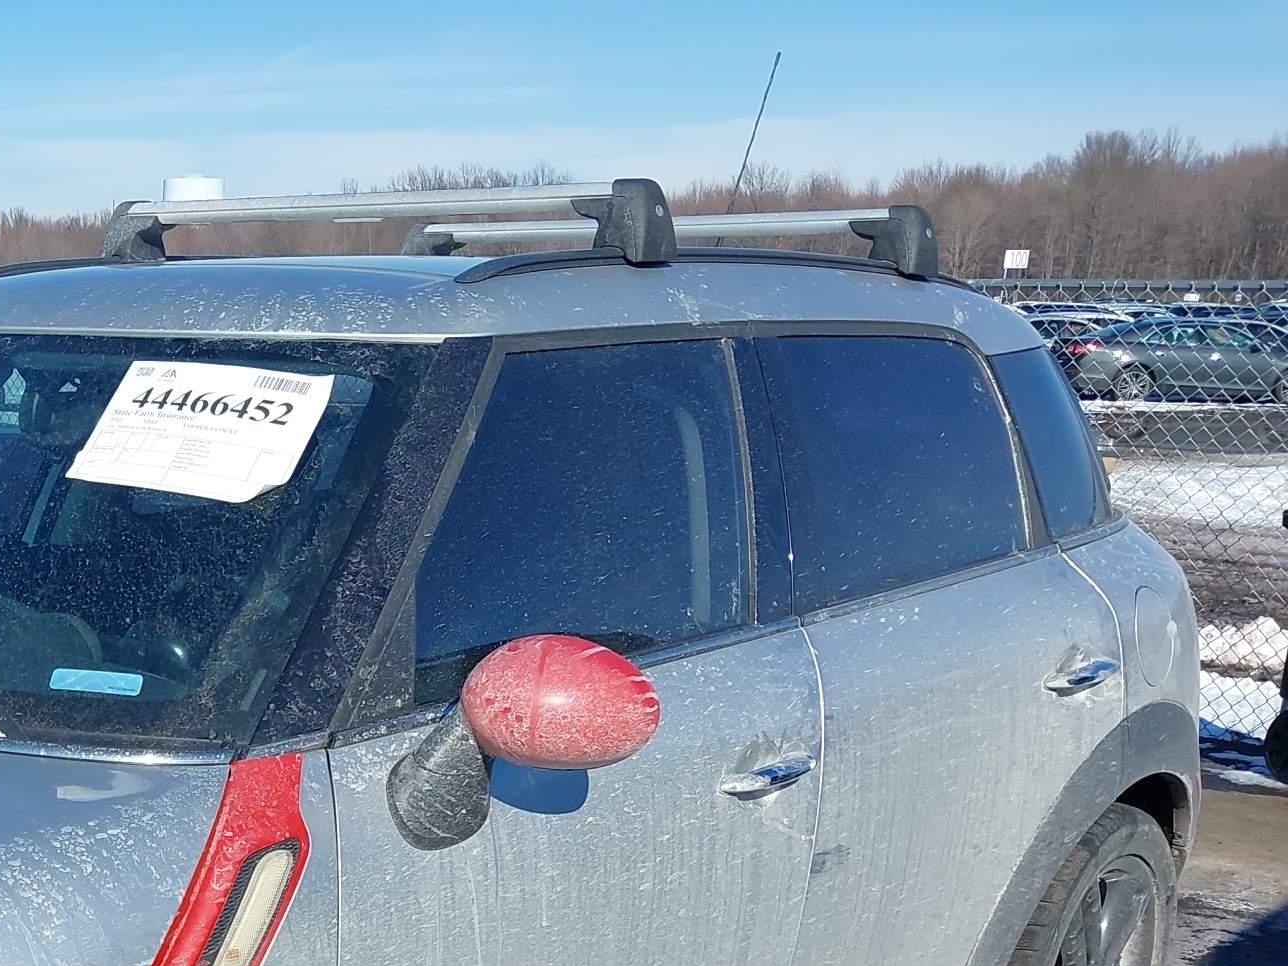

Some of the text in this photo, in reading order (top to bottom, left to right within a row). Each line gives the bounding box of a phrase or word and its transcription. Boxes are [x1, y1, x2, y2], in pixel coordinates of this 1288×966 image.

[1011, 251, 1028, 267] 100
[112, 408, 133, 417] State
[133, 409, 156, 418] Farm
[132, 387, 294, 426] 44466452
